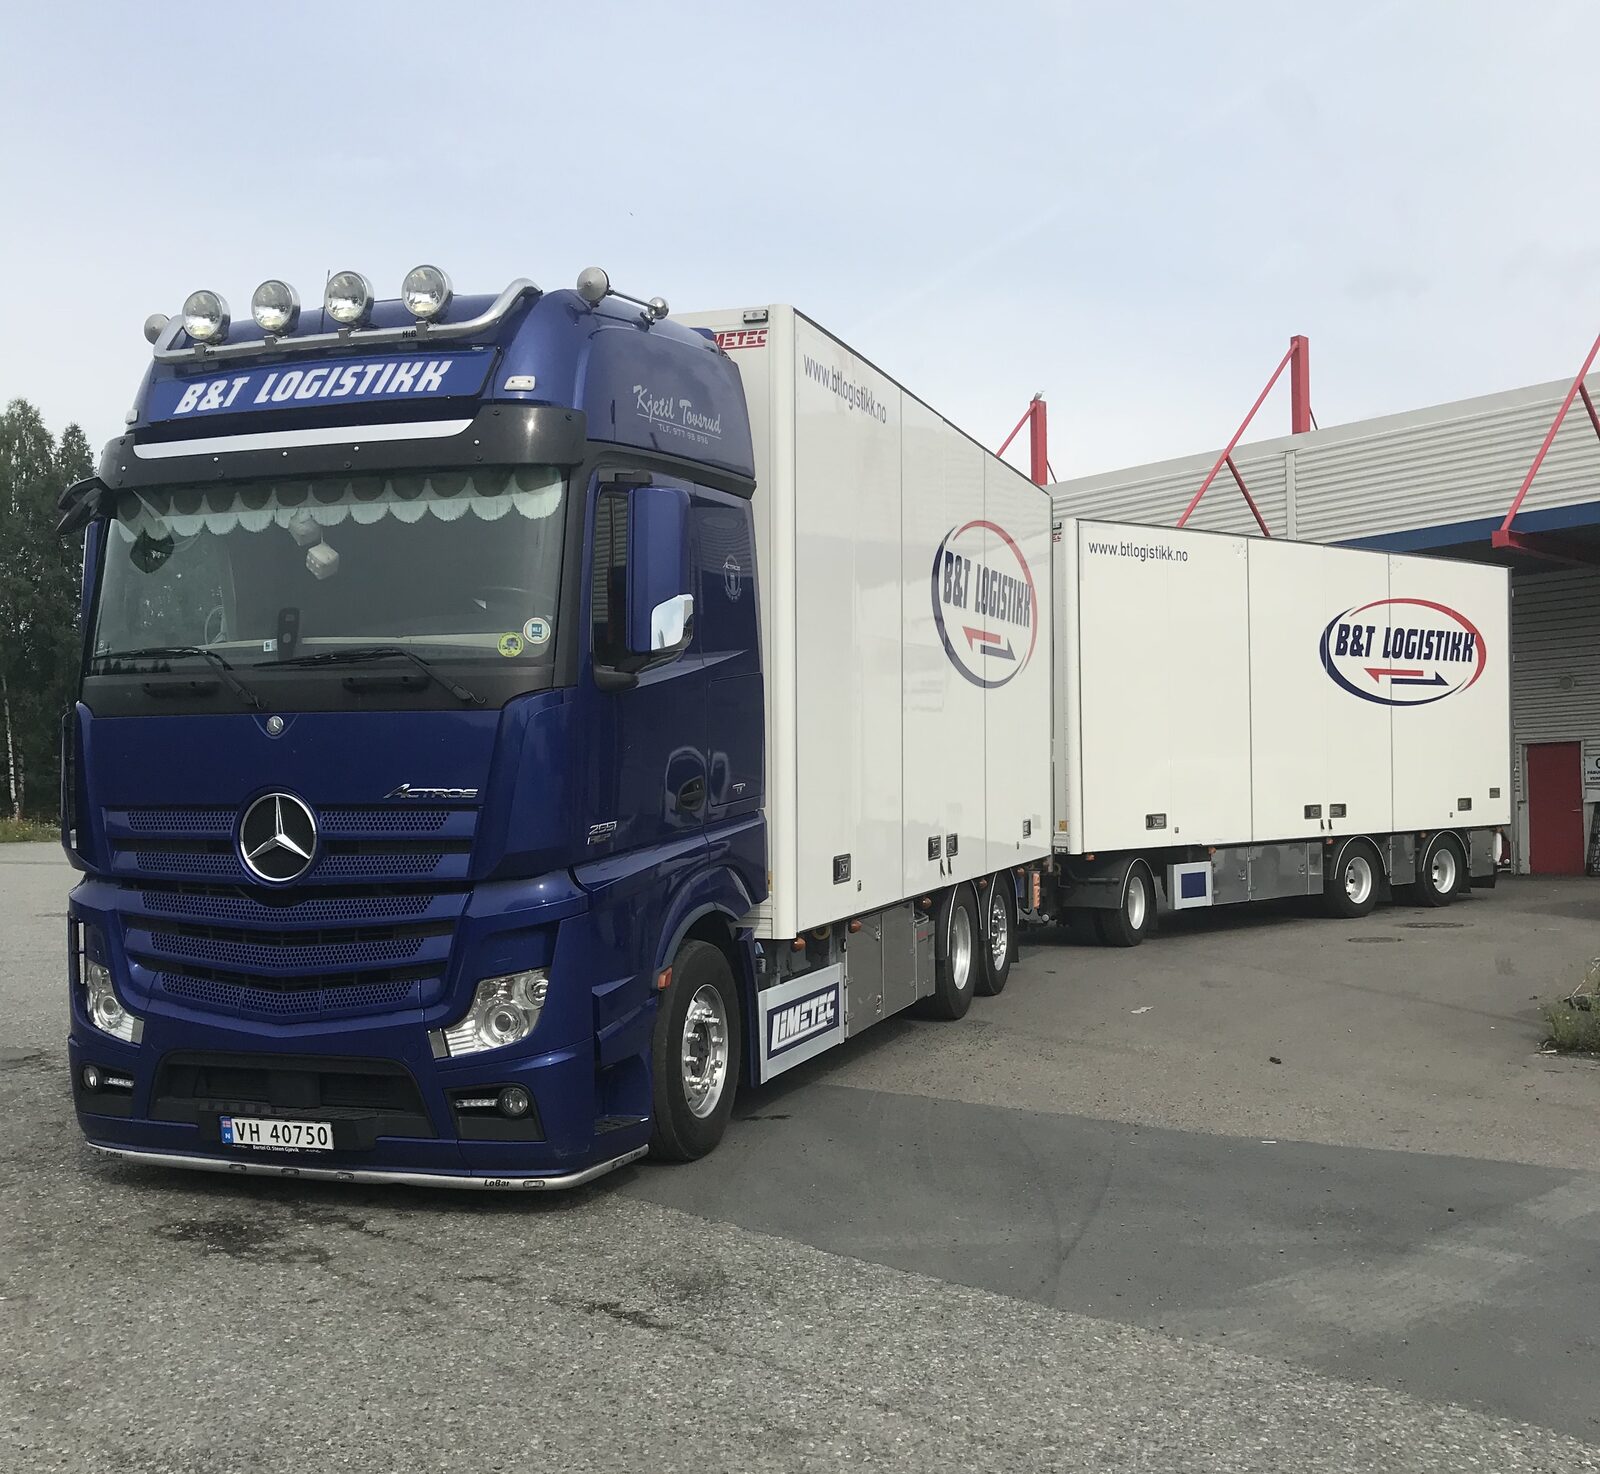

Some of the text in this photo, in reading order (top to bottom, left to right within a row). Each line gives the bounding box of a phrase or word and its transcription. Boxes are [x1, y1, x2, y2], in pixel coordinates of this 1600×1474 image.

[713, 329, 768, 349] METEC
[173, 360, 453, 415] B&T LOGISTIKK
[633, 384, 675, 423] Kjetil
[803, 354, 887, 424] www.btlogistikk.no
[1088, 541, 1188, 562] www.btlogistikk.no
[943, 550, 1032, 628] B&T LOGISTIKK
[1334, 623, 1476, 663] B&T LOGISTIKK
[770, 989, 836, 1052] LIMETEC
[234, 1121, 328, 1146] VH 40750
